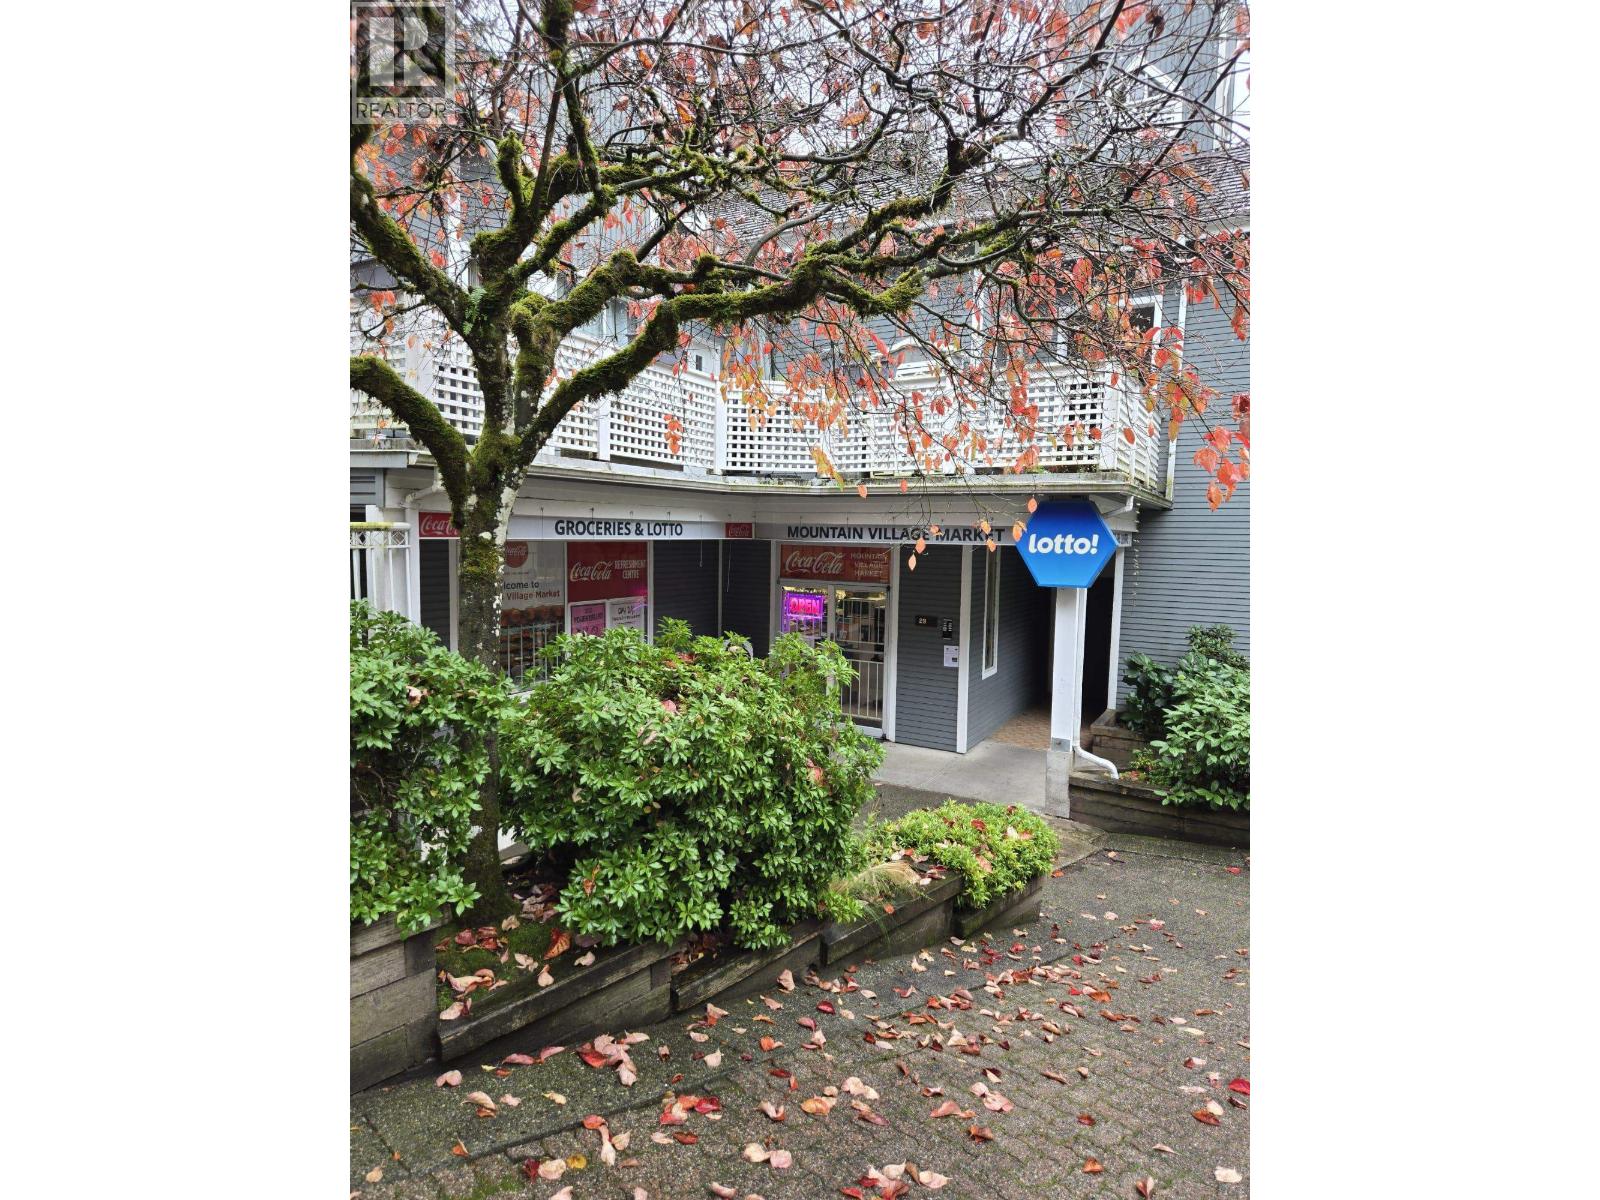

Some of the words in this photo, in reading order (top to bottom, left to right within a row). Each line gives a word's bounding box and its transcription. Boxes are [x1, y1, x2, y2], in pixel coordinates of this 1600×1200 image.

[554, 519, 631, 536] GROCERIES
[634, 522, 644, 536] &
[647, 522, 683, 537] LOTTO
[787, 525, 863, 539] MOUNTAIN
[868, 527, 929, 541] VILLAGE
[1028, 533, 1099, 555] lotto!
[503, 581, 529, 590] lcome
[506, 591, 534, 601] Village
[535, 589, 560, 599] Market
[790, 597, 820, 615] OPEN
